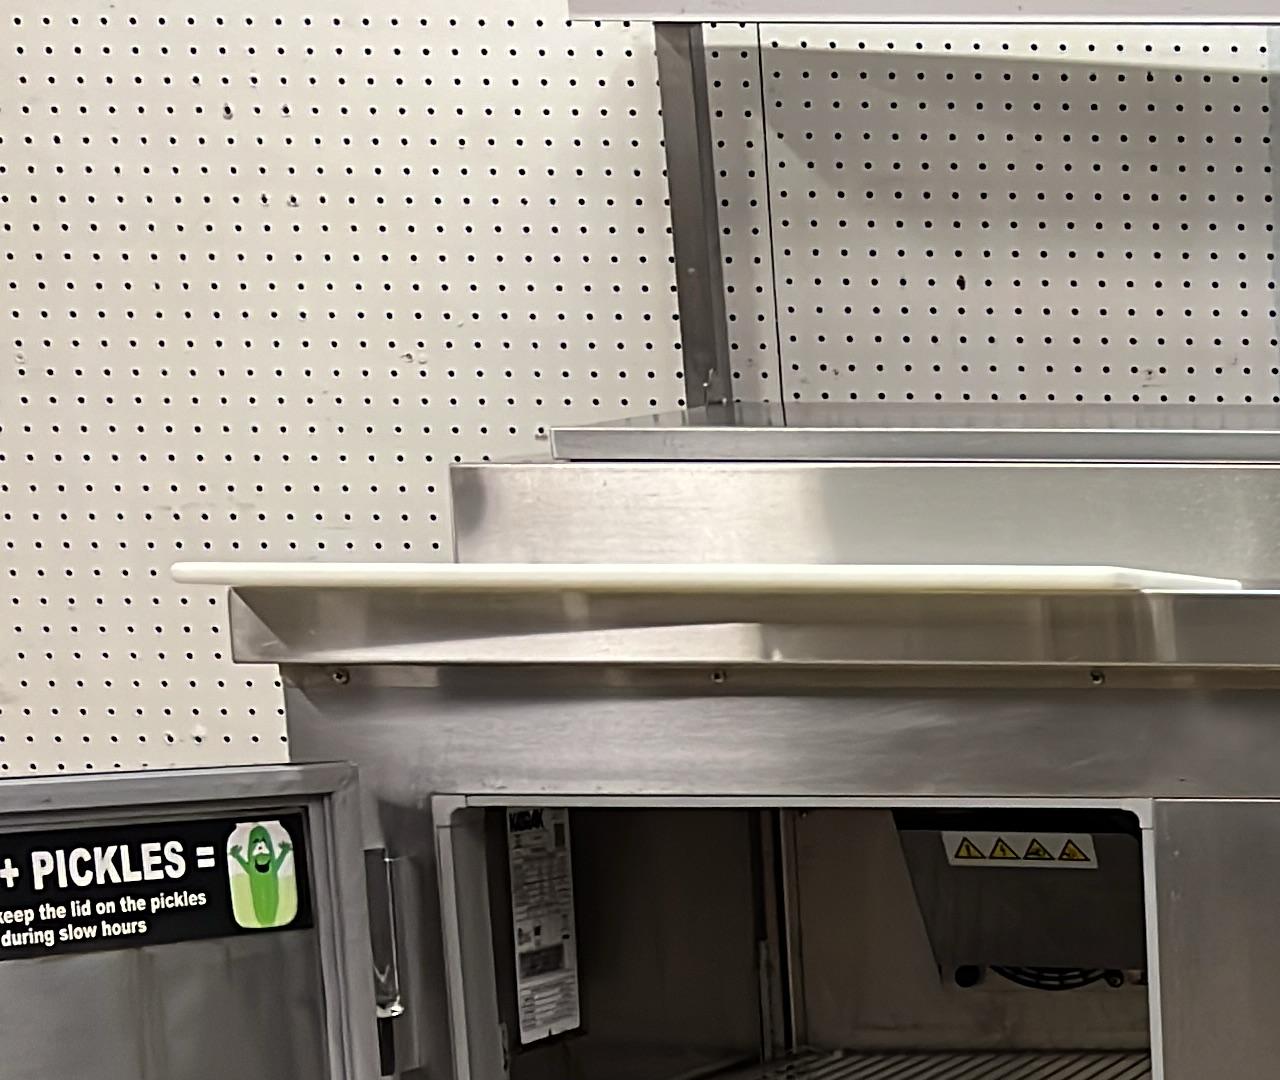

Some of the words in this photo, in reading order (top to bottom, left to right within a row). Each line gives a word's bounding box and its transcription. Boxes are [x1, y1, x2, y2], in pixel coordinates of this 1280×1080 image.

[31, 840, 186, 890] PICKLES
[38, 902, 67, 921] the
[70, 899, 92, 918] lid
[95, 900, 116, 915] on
[120, 895, 147, 913] the
[151, 890, 207, 914] pickles
[1, 928, 55, 947] during
[59, 924, 98, 942] slow
[102, 919, 148, 937] hours
